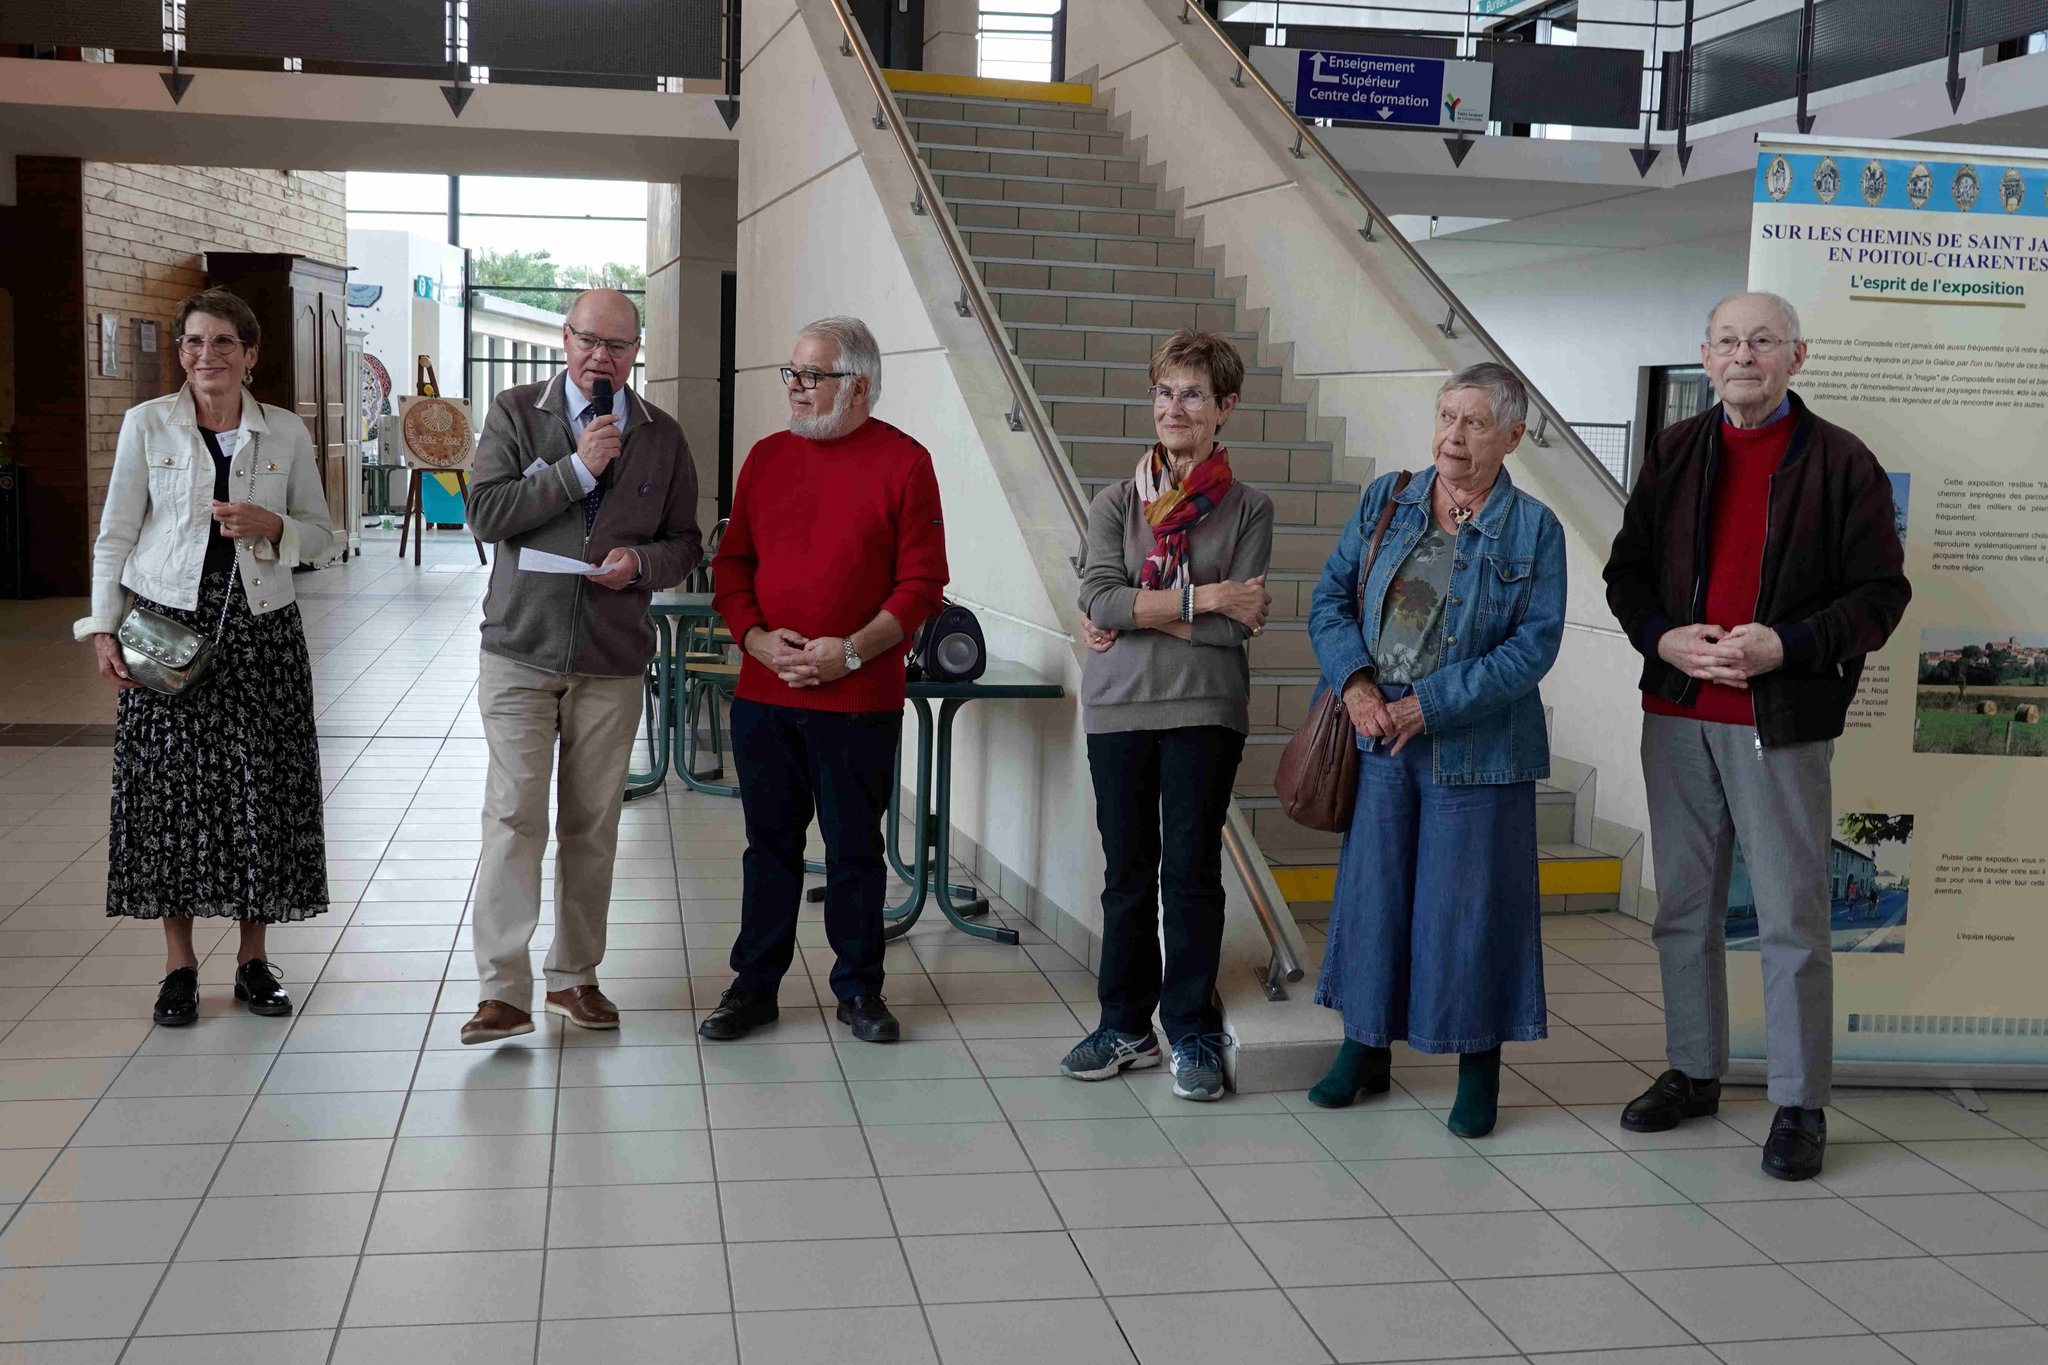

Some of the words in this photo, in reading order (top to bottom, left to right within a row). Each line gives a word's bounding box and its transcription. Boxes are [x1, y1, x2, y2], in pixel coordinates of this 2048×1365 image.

[1329, 56, 1415, 73] Enseignement
[1341, 73, 1400, 89] Supérieur
[1309, 88, 1349, 102] Centre
[1352, 91, 1367, 102] de
[1369, 92, 1429, 107] formation
[1762, 224, 1802, 240] SUR
[1808, 225, 1842, 241] LES
[1847, 227, 1931, 247] CHEMINS
[1937, 233, 1962, 248] DE
[1968, 234, 2024, 251] SAINT
[1828, 246, 1853, 262] EN
[1859, 248, 2048, 272] POITOU-CHARENTES
[1850, 274, 1906, 293] L'esprit
[1910, 278, 1928, 292] de
[1933, 279, 2024, 296] l'exposition
[1815, 337, 1842, 346] chemins
[1844, 338, 1852, 346] de
[1853, 338, 1893, 348] Compostelle
[1895, 341, 1911, 349] n'ont
[1910, 341, 1933, 350] jamais
[1934, 342, 1945, 350] été
[1968, 344, 2004, 352] fréquentés
[2021, 346, 2037, 354] notre
[1828, 354, 1862, 362] aujourd'hui
[1873, 356, 1900, 364] rejoindre
[1910, 358, 1924, 366] jour
[1933, 358, 1955, 366] Galice
[1994, 360, 2015, 368] l'autre
[1831, 369, 1843, 377] des
[1951, 374, 1994, 383] Compostelle
[1996, 376, 2016, 384] existe
[1797, 380, 1815, 389] quête
[1860, 383, 1911, 392] l'émerveillement
[1911, 385, 1934, 393] devant
[1946, 387, 1980, 396] paysages
[1814, 393, 1849, 401] patrimoine,
[1902, 396, 1932, 405] légendes
[1960, 399, 1994, 407] rencontre
[1944, 478, 1963, 486] Cette
[1967, 479, 2004, 488] exposition
[1937, 490, 1966, 498] chemins
[1970, 492, 2006, 500] imprégnés
[1986, 503, 2012, 511] milliers
[1935, 528, 1953, 536] Nous
[1979, 530, 2029, 538] volontairement
[1974, 542, 2037, 551] systématiquement
[1932, 552, 1964, 560] jacquaire
[2020, 554, 2036, 562] villes
[1861, 698, 1888, 706] l'accueil
[1942, 853, 1963, 861] Puisse
[1985, 855, 2018, 863] exposition
[1962, 865, 1975, 873] jour
[1984, 866, 2008, 874] boucler
[1956, 932, 1984, 941] L'équipe
[1985, 933, 2016, 942] régionale
